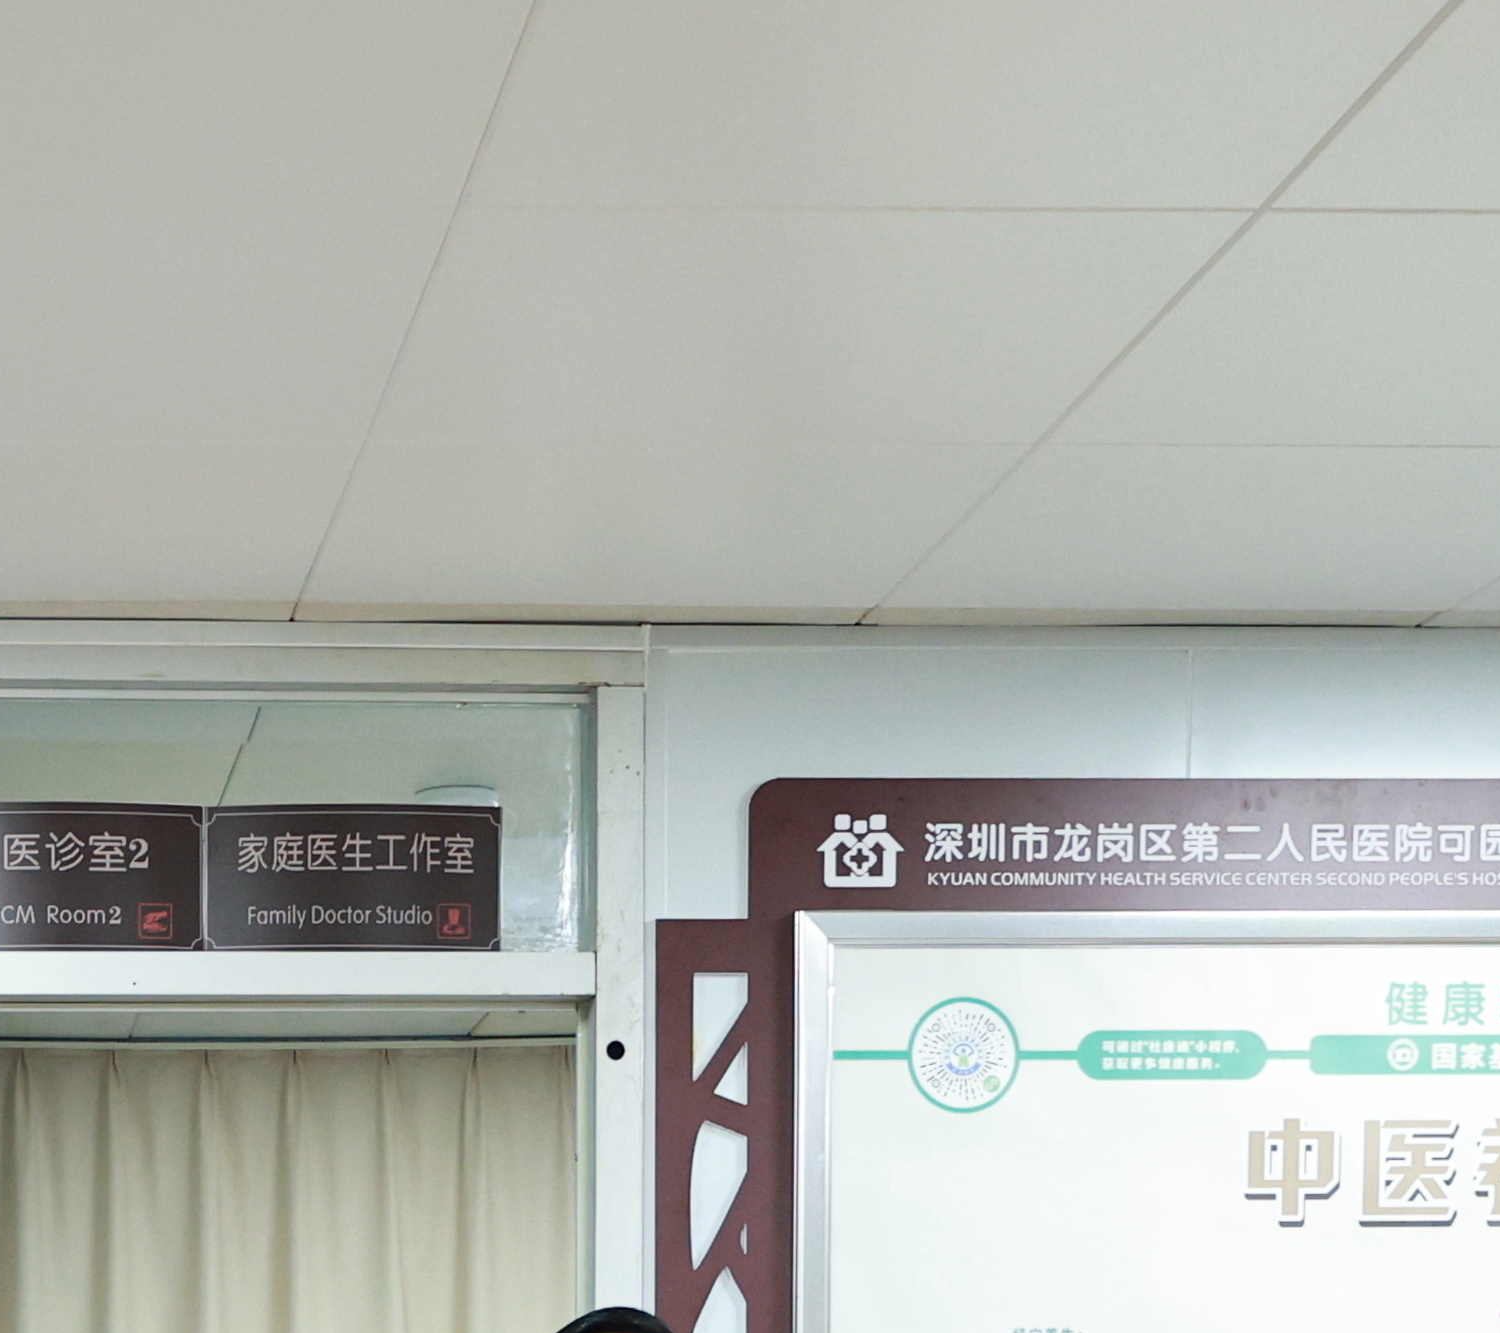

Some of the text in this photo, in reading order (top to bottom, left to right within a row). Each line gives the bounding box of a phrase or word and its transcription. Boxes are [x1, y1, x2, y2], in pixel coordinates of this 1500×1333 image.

[236, 834, 476, 874] 家庭医生工作室
[927, 871, 987, 887] KYUAN
[991, 871, 1097, 887] COMMUNITY
[1100, 871, 1166, 887] HEALTH
[1170, 871, 1242, 887] SERVICE
[1246, 871, 1313, 887] CENTER
[1316, 871, 1385, 887] SECOND
[1390, 871, 1469, 887] PEOPLE'S
[247, 903, 433, 930] Family Doctor Studio
